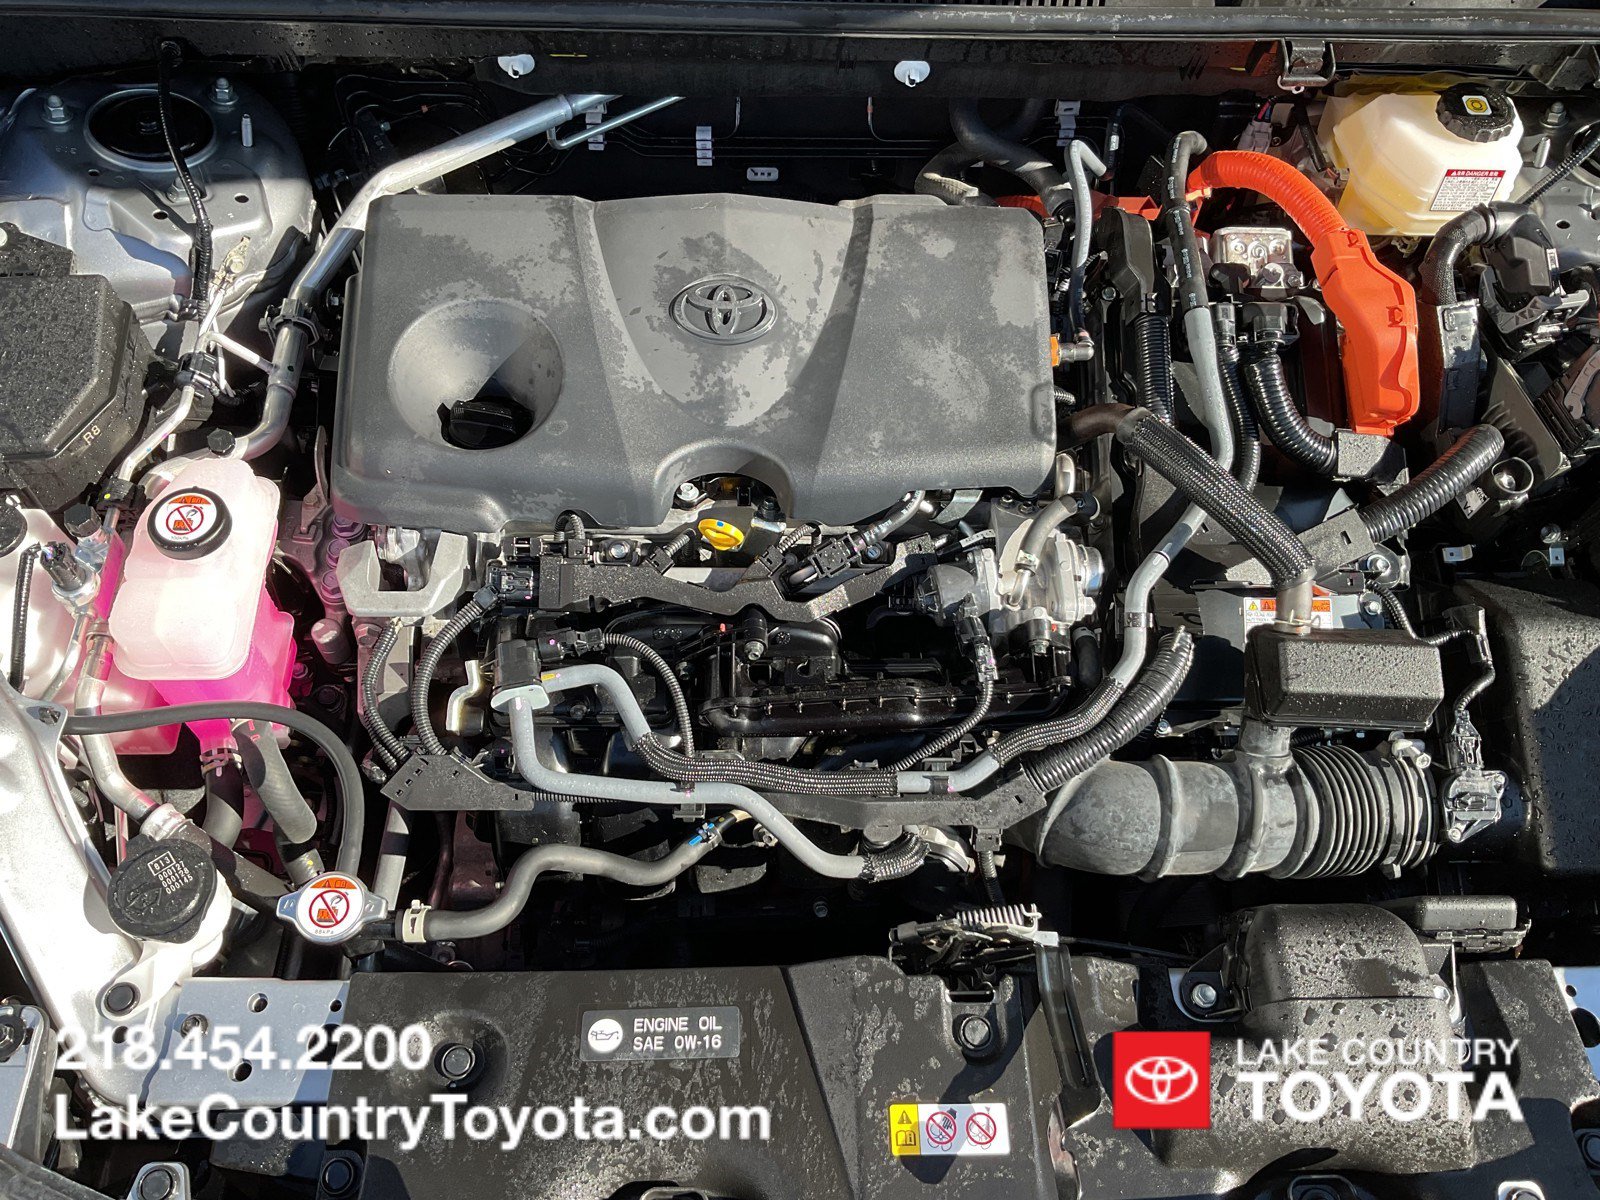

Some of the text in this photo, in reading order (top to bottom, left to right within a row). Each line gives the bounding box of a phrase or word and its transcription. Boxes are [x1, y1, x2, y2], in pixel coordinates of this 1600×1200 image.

[83, 425, 100, 445] R8
[158, 860, 185, 881] 000127
[162, 867, 189, 888] 000128
[165, 874, 193, 894] 000145
[633, 1015, 723, 1033] ENGINE OIL
[633, 1033, 722, 1052] SAE 0W-16
